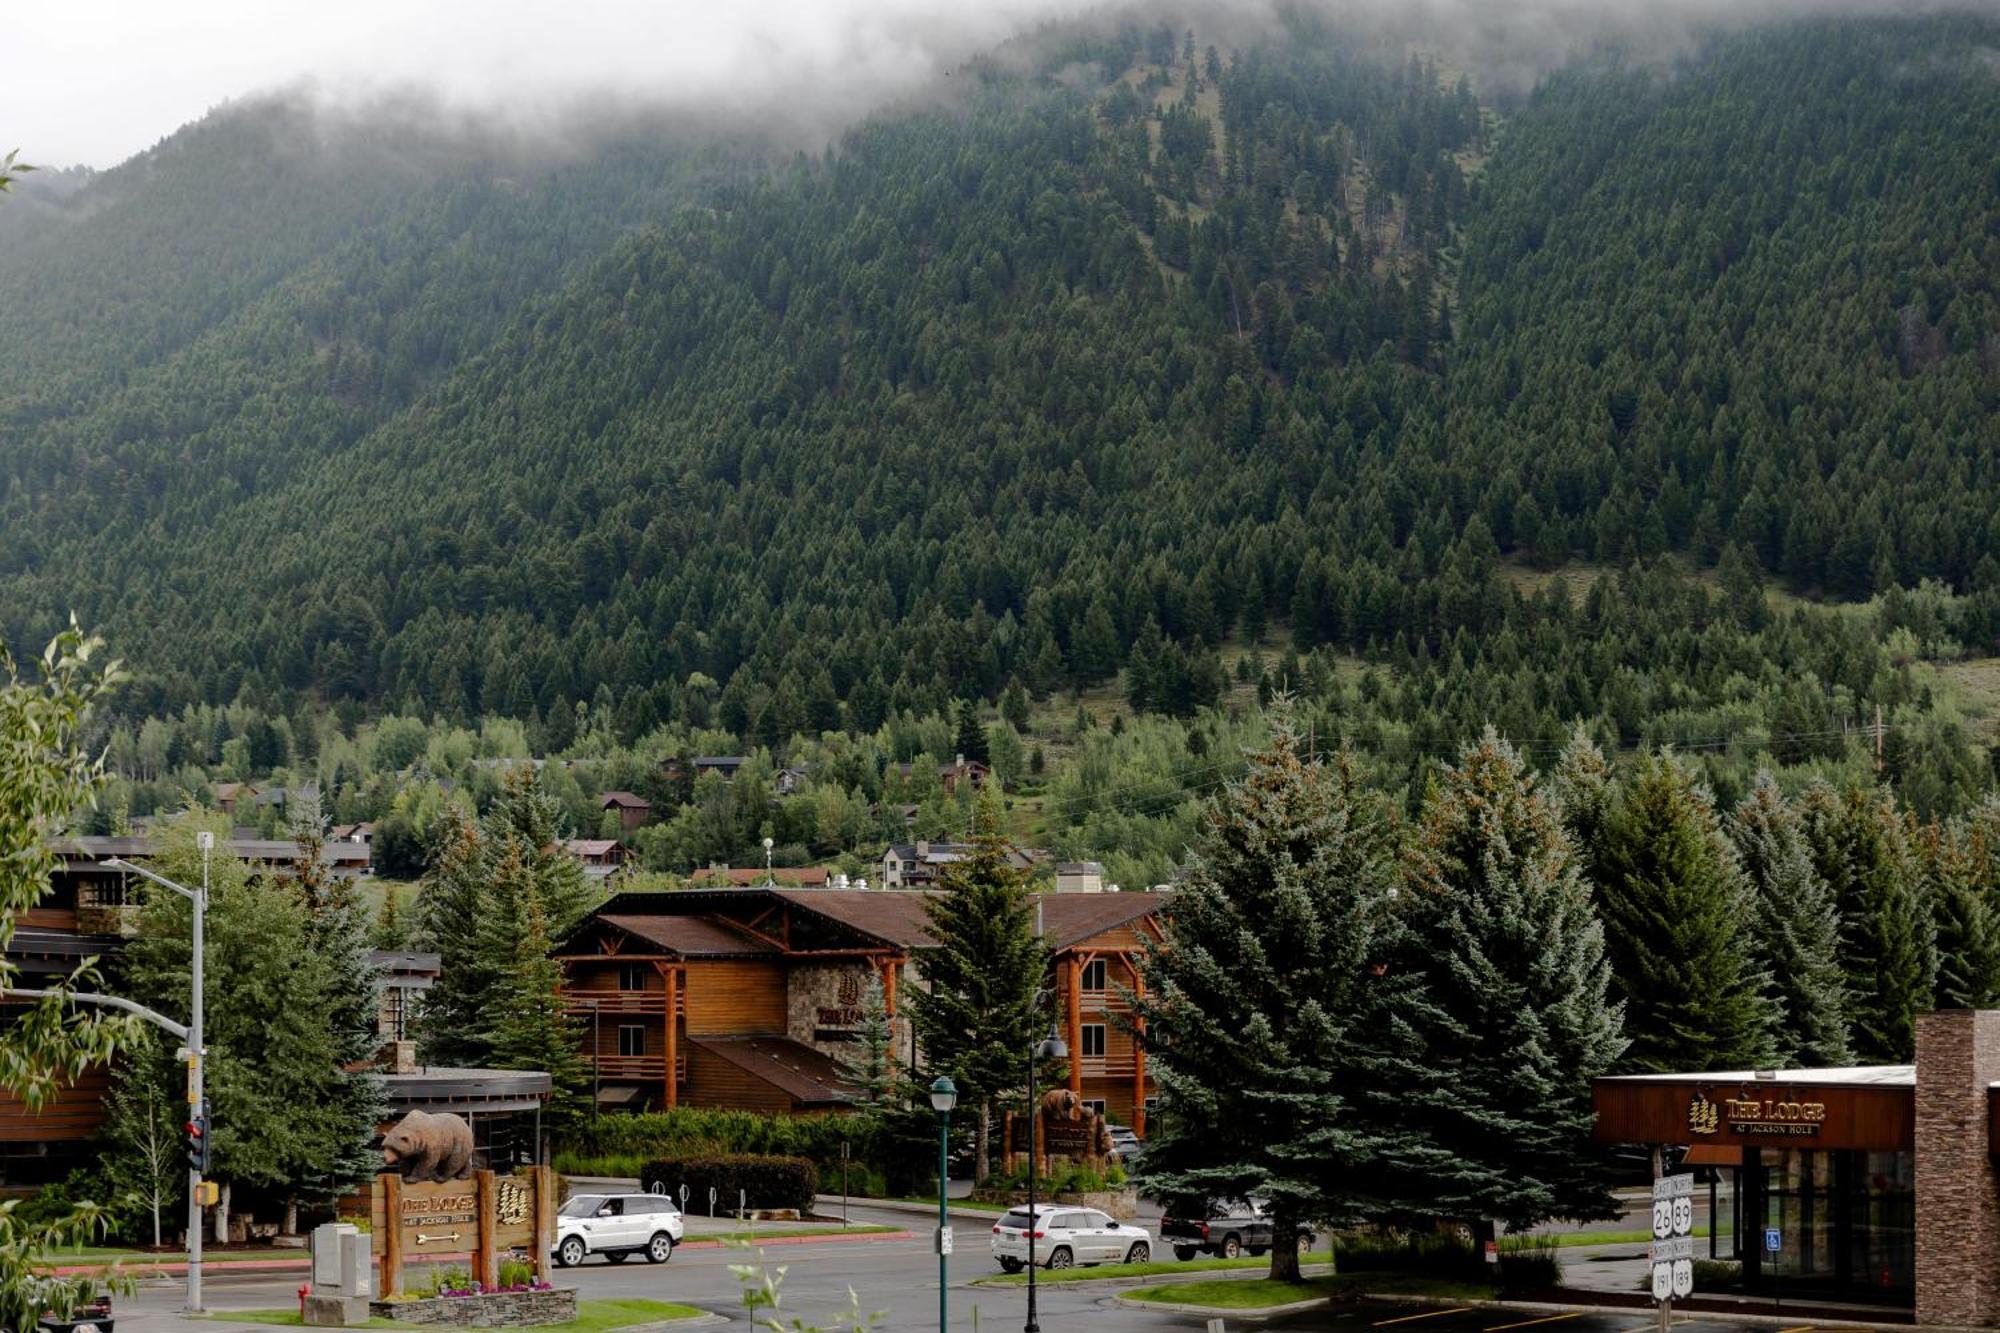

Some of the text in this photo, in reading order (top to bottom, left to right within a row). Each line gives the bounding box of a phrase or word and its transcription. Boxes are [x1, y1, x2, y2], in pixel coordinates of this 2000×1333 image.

[1725, 1099, 1826, 1120] THE LODGE
[1736, 1125, 1813, 1135] AT JACKSON HOLE
[1675, 1178, 1693, 1192] NORTH
[402, 1196, 474, 1213] THE LODGE
[1655, 1209, 1670, 1229] 26
[1675, 1205, 1690, 1226] 89
[1656, 1274, 1669, 1289] 191
[1676, 1271, 1689, 1287] 189
